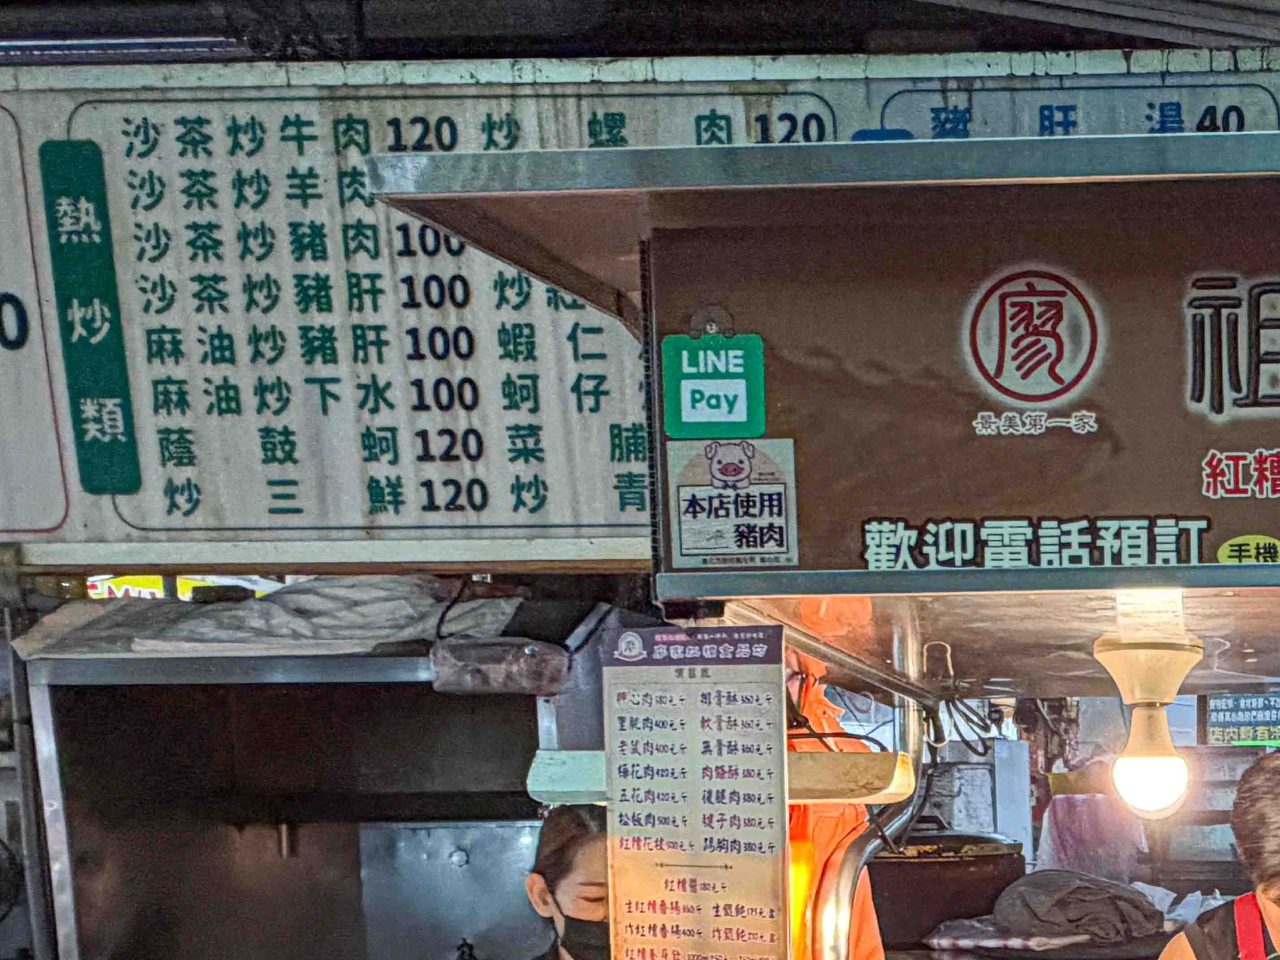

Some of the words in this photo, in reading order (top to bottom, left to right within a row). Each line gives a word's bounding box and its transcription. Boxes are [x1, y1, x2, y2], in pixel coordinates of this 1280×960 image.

[123, 116, 371, 157] 沙茶炒牛肉
[385, 117, 457, 152] 120
[754, 113, 826, 143] 120
[1196, 106, 1245, 132] 40
[127, 169, 374, 210] 沙茶炒羊肉
[134, 222, 379, 262] 沙茶炒豬肉
[137, 273, 384, 315] 沙茶炒豬肝
[401, 276, 469, 309] 100
[55, 197, 125, 443] 熱炒類
[146, 325, 390, 367] 麻油炒豬肝
[406, 327, 473, 361] 100
[681, 350, 744, 373] LINE
[151, 375, 395, 417] 麻油炒下水
[410, 378, 477, 411] 100
[690, 389, 738, 413] Pay
[973, 410, 1097, 435] 景美第一家
[414, 429, 483, 462] 120
[164, 479, 406, 517] 炒三鮮
[420, 479, 488, 512] 120
[682, 492, 784, 519] 本店使用
[733, 523, 785, 549] 豬肉
[864, 518, 1208, 570] 歡迎電話預訂
[1227, 544, 1279, 564] 手機
